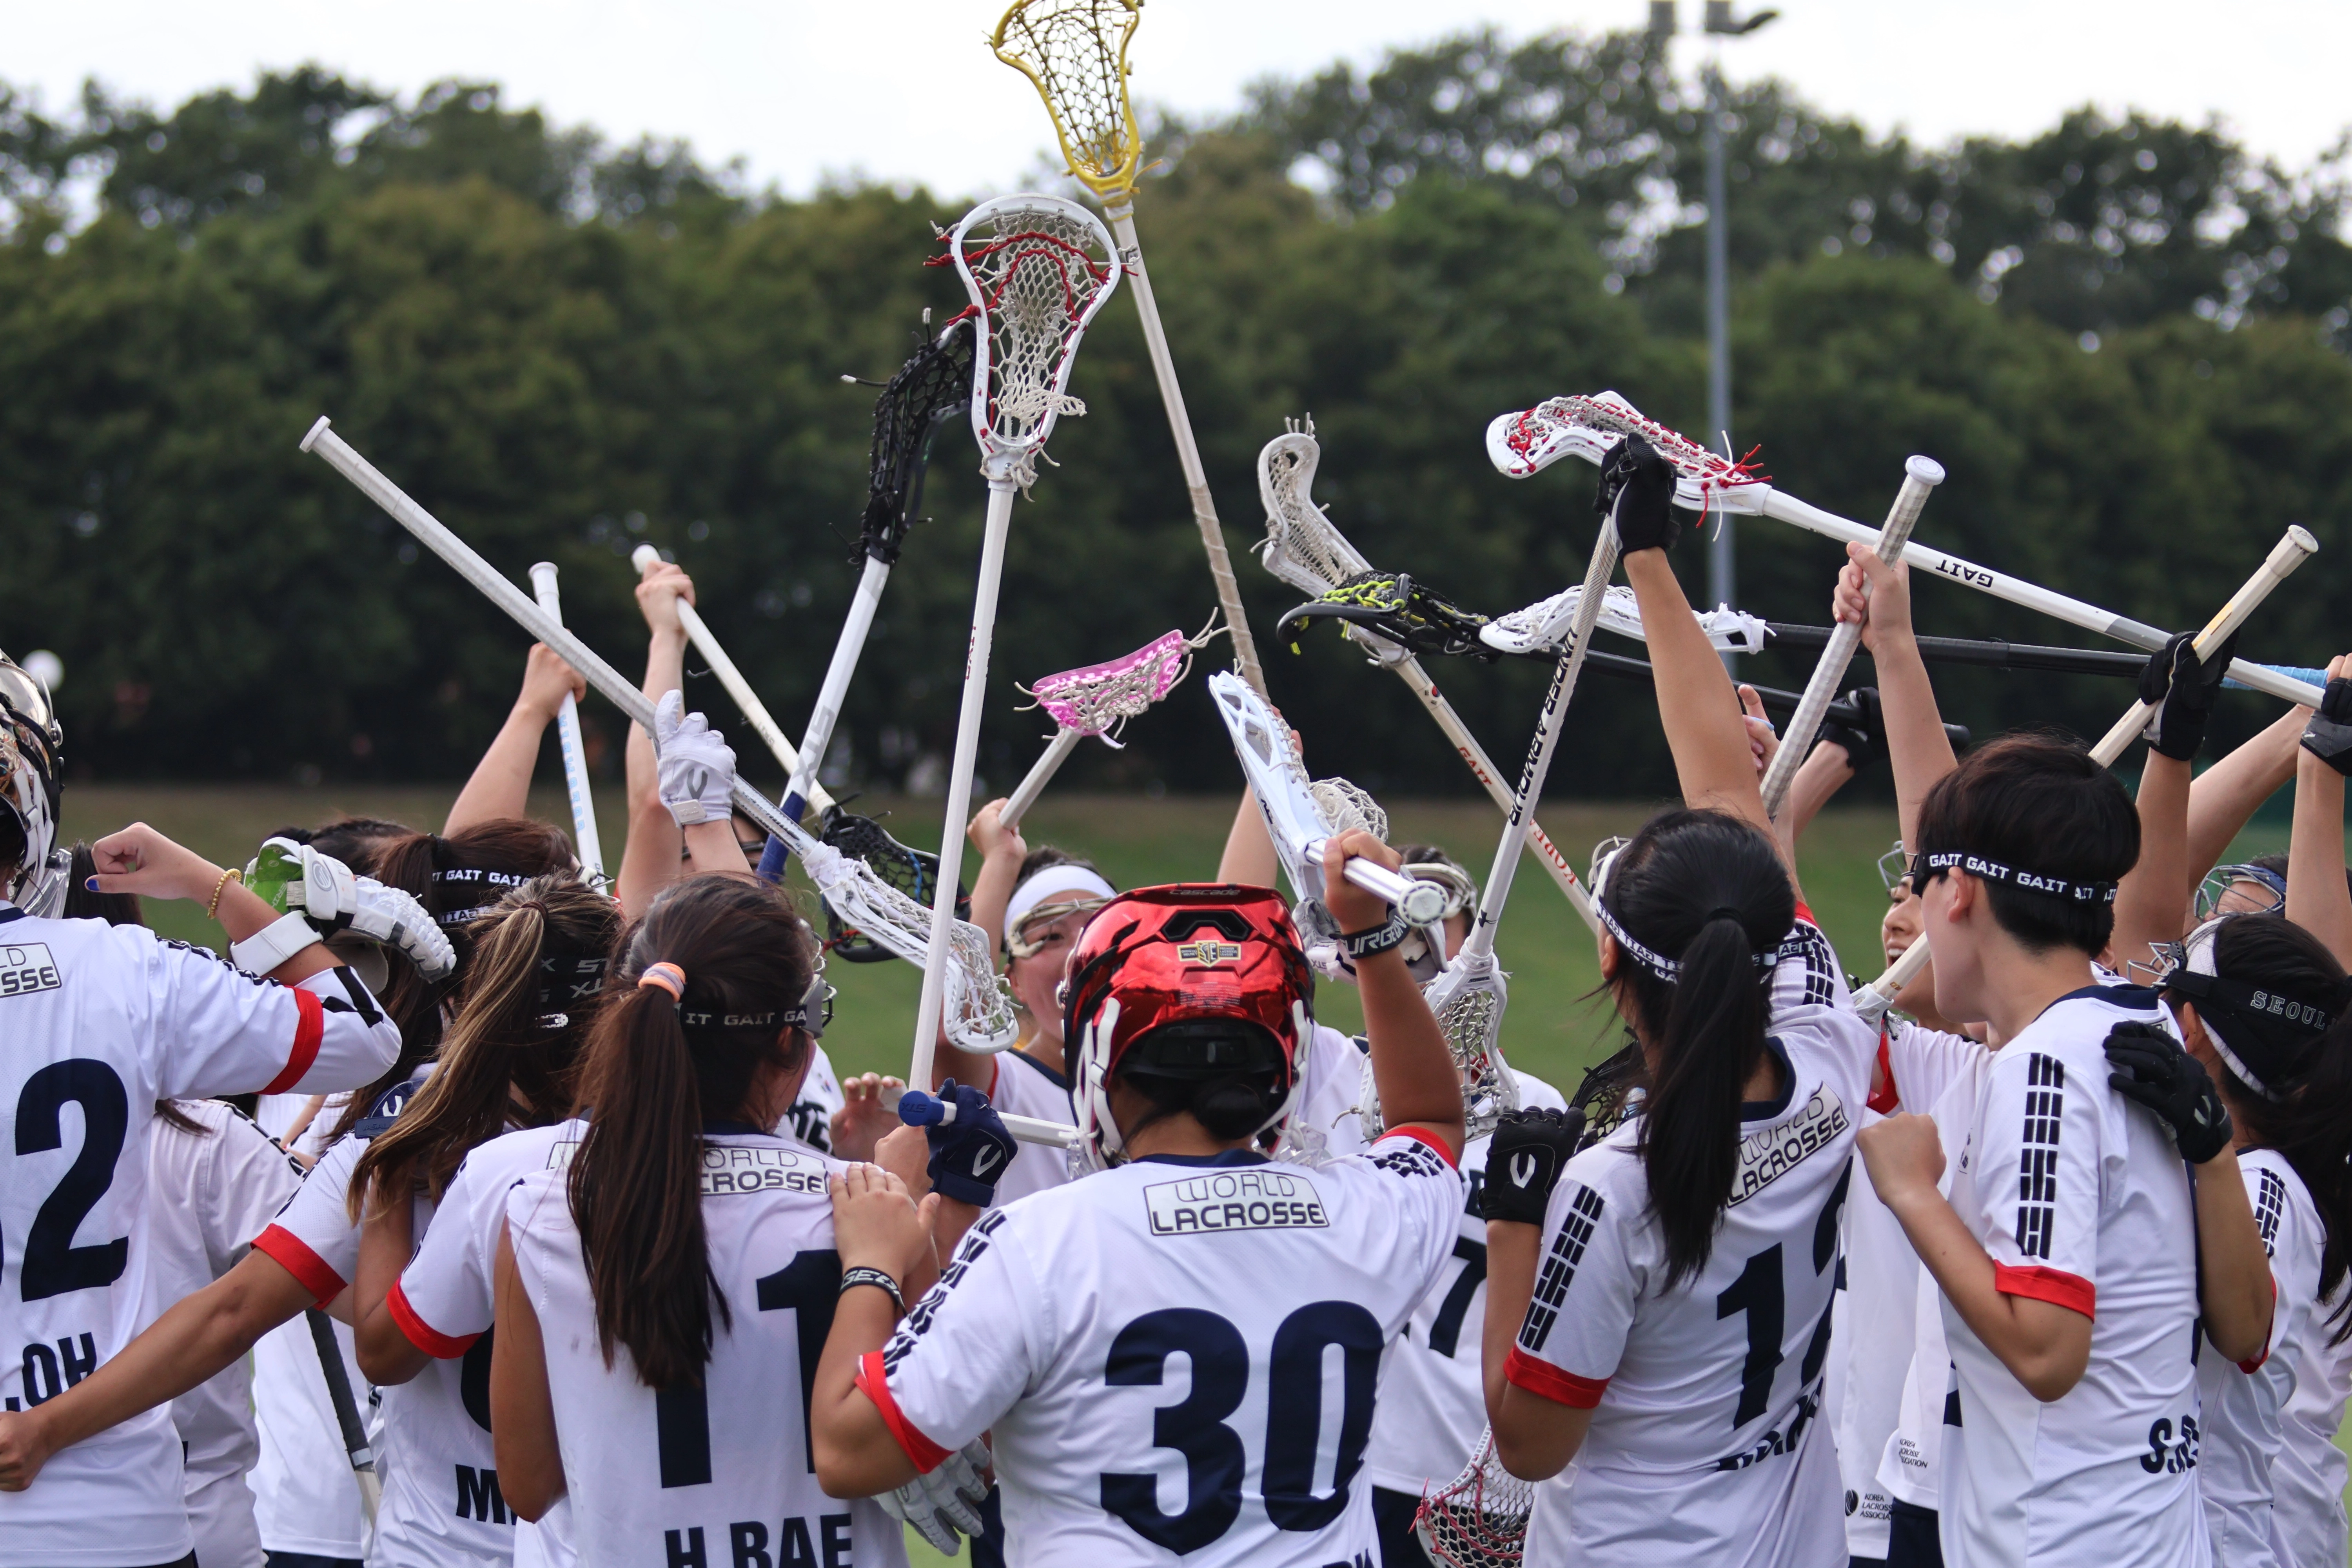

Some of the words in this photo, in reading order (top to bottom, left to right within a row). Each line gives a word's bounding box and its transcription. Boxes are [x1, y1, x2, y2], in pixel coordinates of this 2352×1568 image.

[1935, 559, 1993, 588] GAIT
[1545, 627, 1578, 715] UNDER
[790, 704, 836, 790] STX
[1459, 747, 1492, 785] GAIT
[1509, 721, 1547, 826] ARMOUR
[446, 869, 482, 881] GAIT
[1929, 854, 1962, 867] GAIT
[1966, 857, 2009, 879] GAIT
[2016, 872, 2067, 893] GAIT
[2074, 887, 2094, 900] AIT
[1345, 915, 1407, 955] URGEON
[686, 1013, 712, 1025] IT
[724, 1012, 775, 1025] GAIT
[784, 1010, 807, 1022] GA
[2250, 991, 2325, 1030] SEOUL
[901, 1103, 927, 1113] STX
[704, 1149, 799, 1169] ORLD
[1729, 1105, 1844, 1203] LACROSSE
[701, 1169, 823, 1193] ROSSE
[1176, 1174, 1295, 1201] WORLD
[1153, 1203, 1325, 1232] LACROSSE
[1100, 1301, 1384, 1555] 30
[1900, 1438, 1916, 1448] KOREA
[1900, 1448, 1920, 1457] CROSSE
[1901, 1456, 1928, 1468] SOCIATION
[1862, 1502, 1893, 1511] LACROSS
[1864, 1493, 1884, 1502] KOREA
[1860, 1510, 1891, 1520] ASSOCIA
